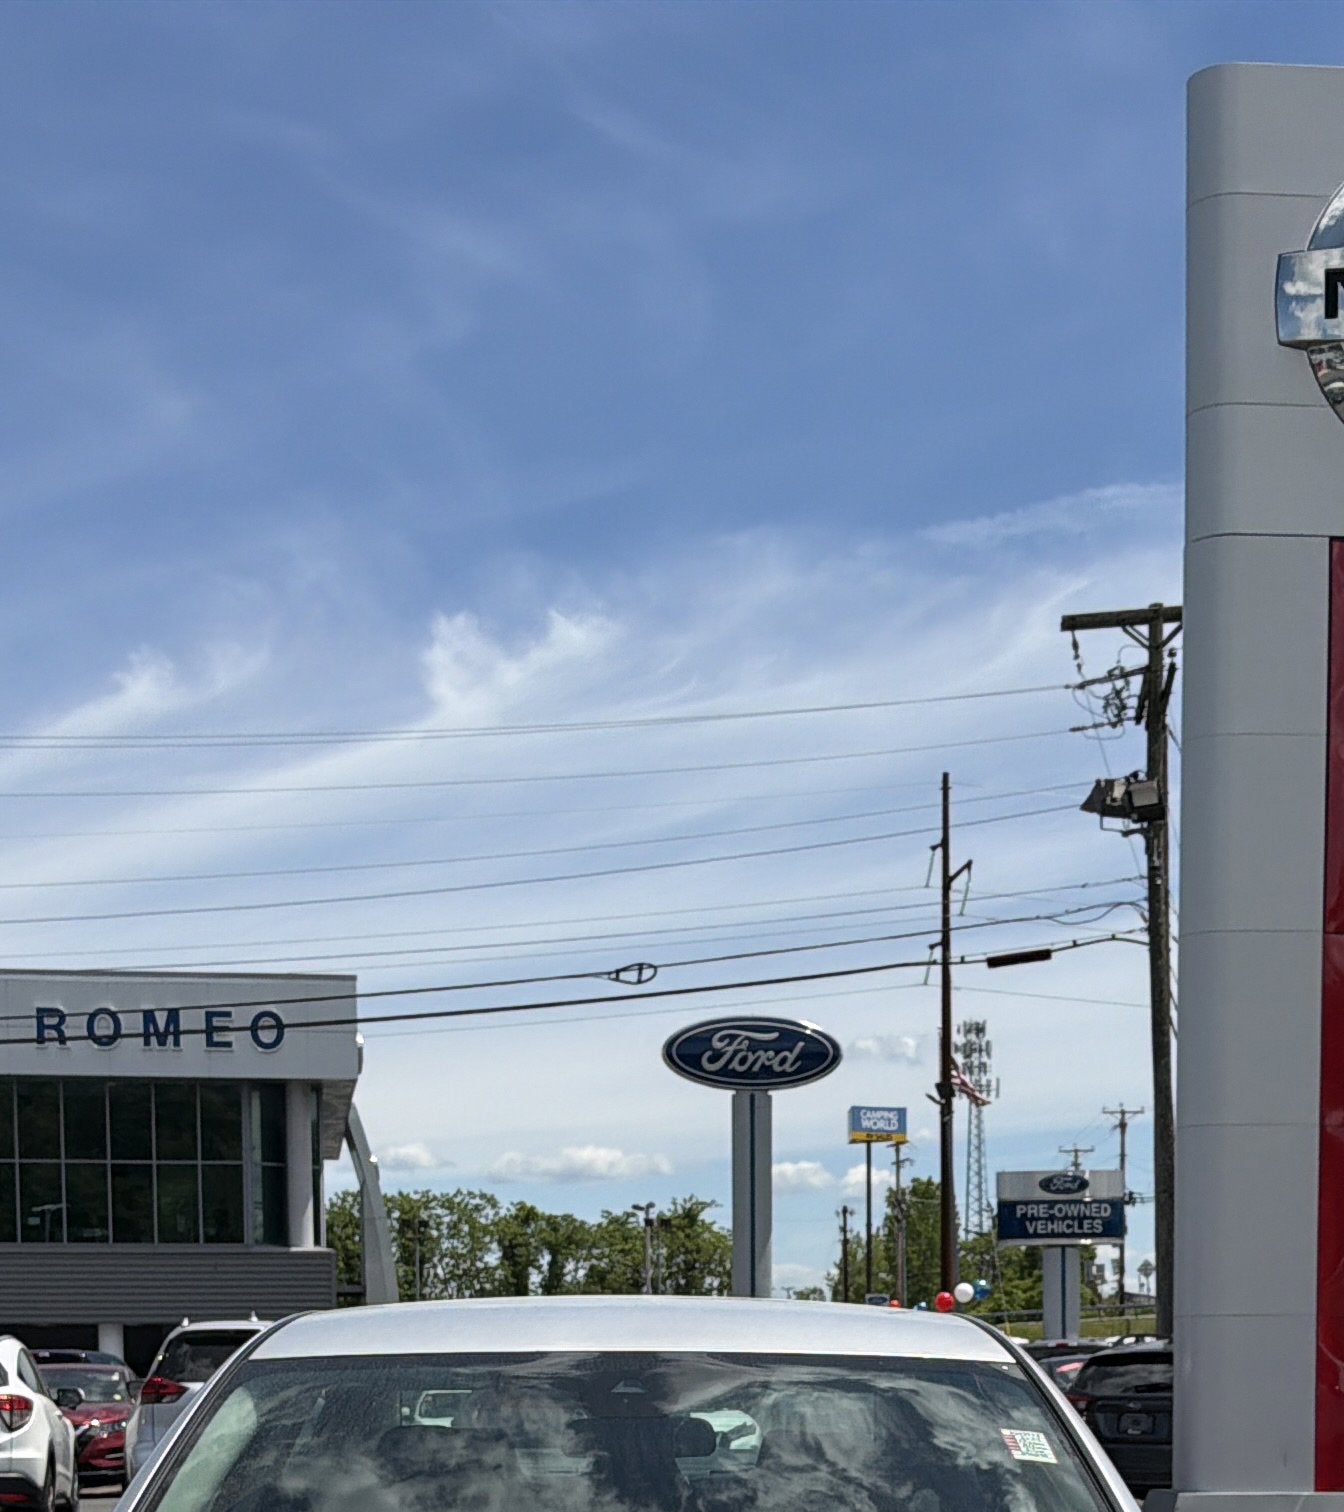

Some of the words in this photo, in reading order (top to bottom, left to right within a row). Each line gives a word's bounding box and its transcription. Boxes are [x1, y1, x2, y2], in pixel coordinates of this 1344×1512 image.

[35, 1006, 285, 1050] ROMEO
[701, 1029, 805, 1073] Ford
[860, 1109, 898, 1120] CAMPING
[861, 1119, 899, 1131] WORLD
[1049, 1176, 1081, 1191] Ford
[1016, 1203, 1111, 1218] PRE-OWNED
[1025, 1219, 1104, 1235] VEHICLES
